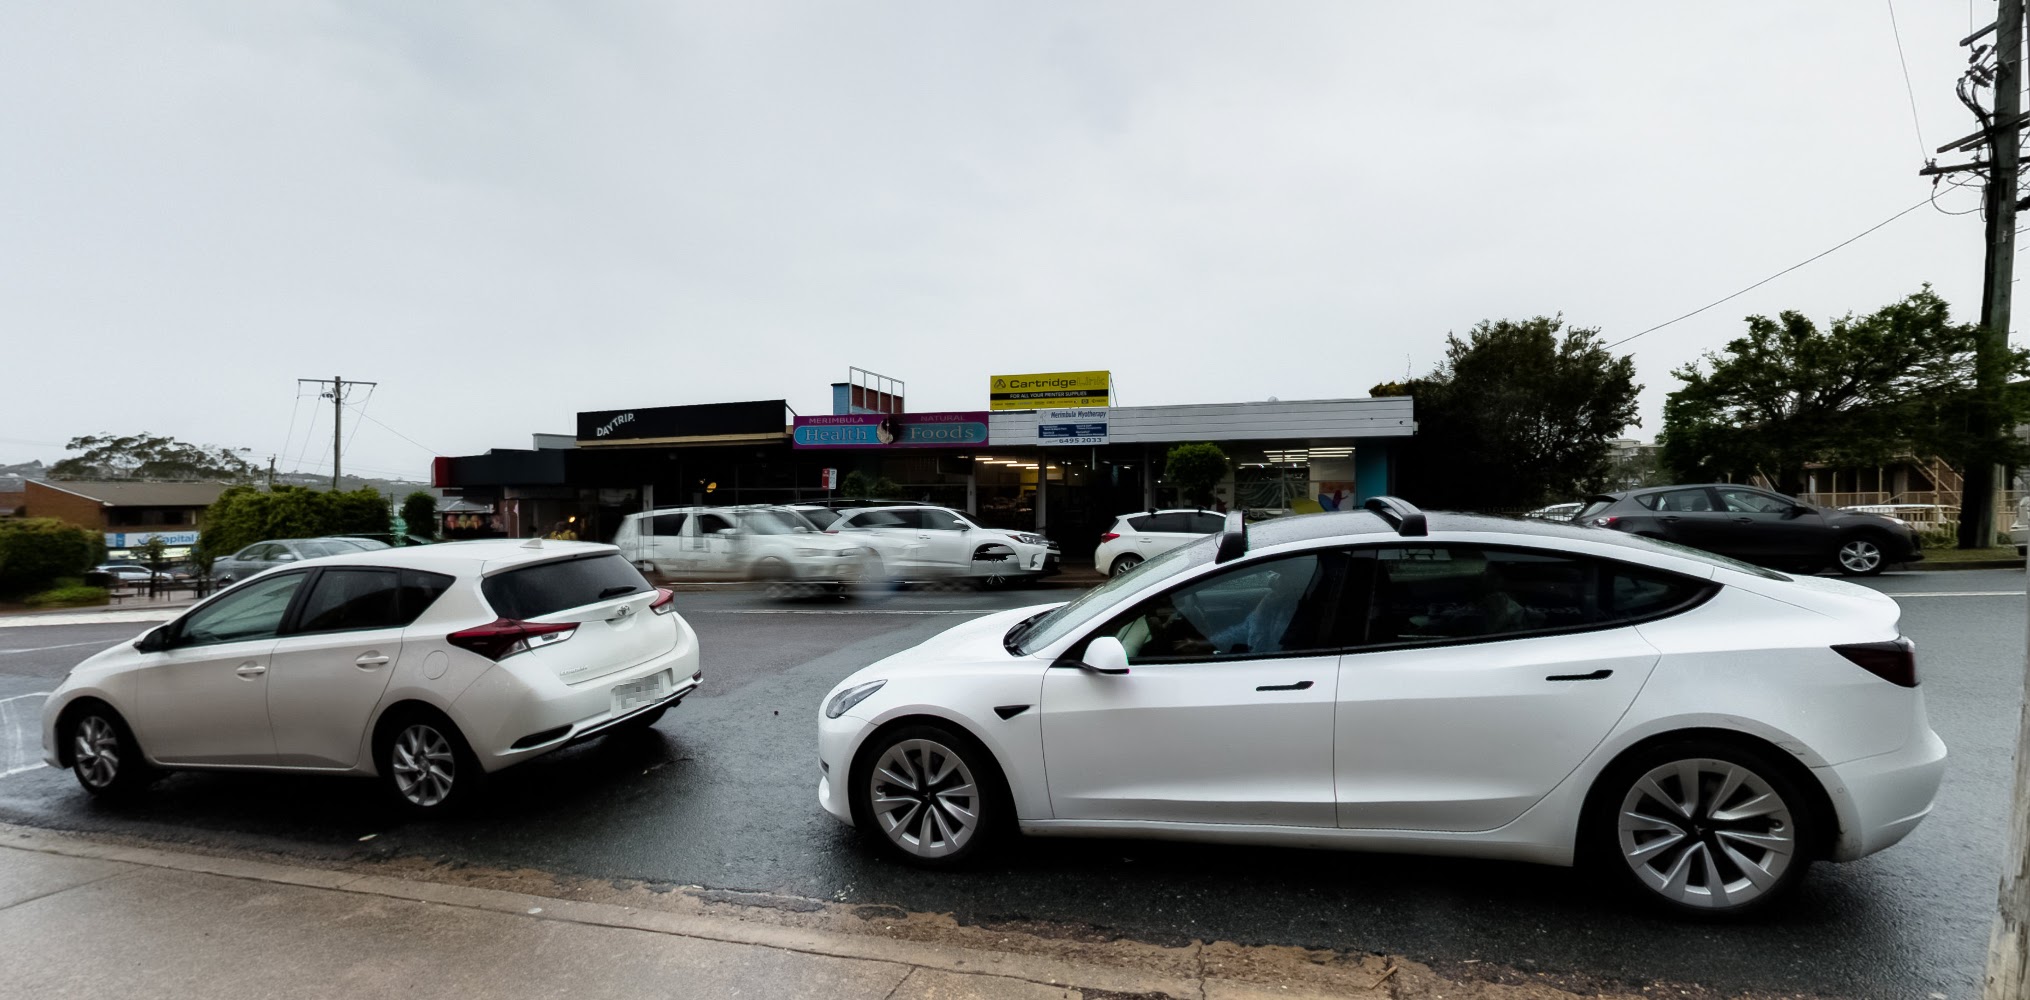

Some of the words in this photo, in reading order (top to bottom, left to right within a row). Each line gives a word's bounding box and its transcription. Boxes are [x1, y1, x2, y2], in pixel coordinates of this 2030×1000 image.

[920, 414, 965, 422] NATURAL
[1050, 411, 1077, 419] Merimbula
[1077, 409, 1107, 419] Myotherapy
[808, 416, 864, 424] MERIMBULA
[805, 427, 867, 442] Health
[911, 425, 974, 440] Foods
[155, 533, 195, 545] apital
